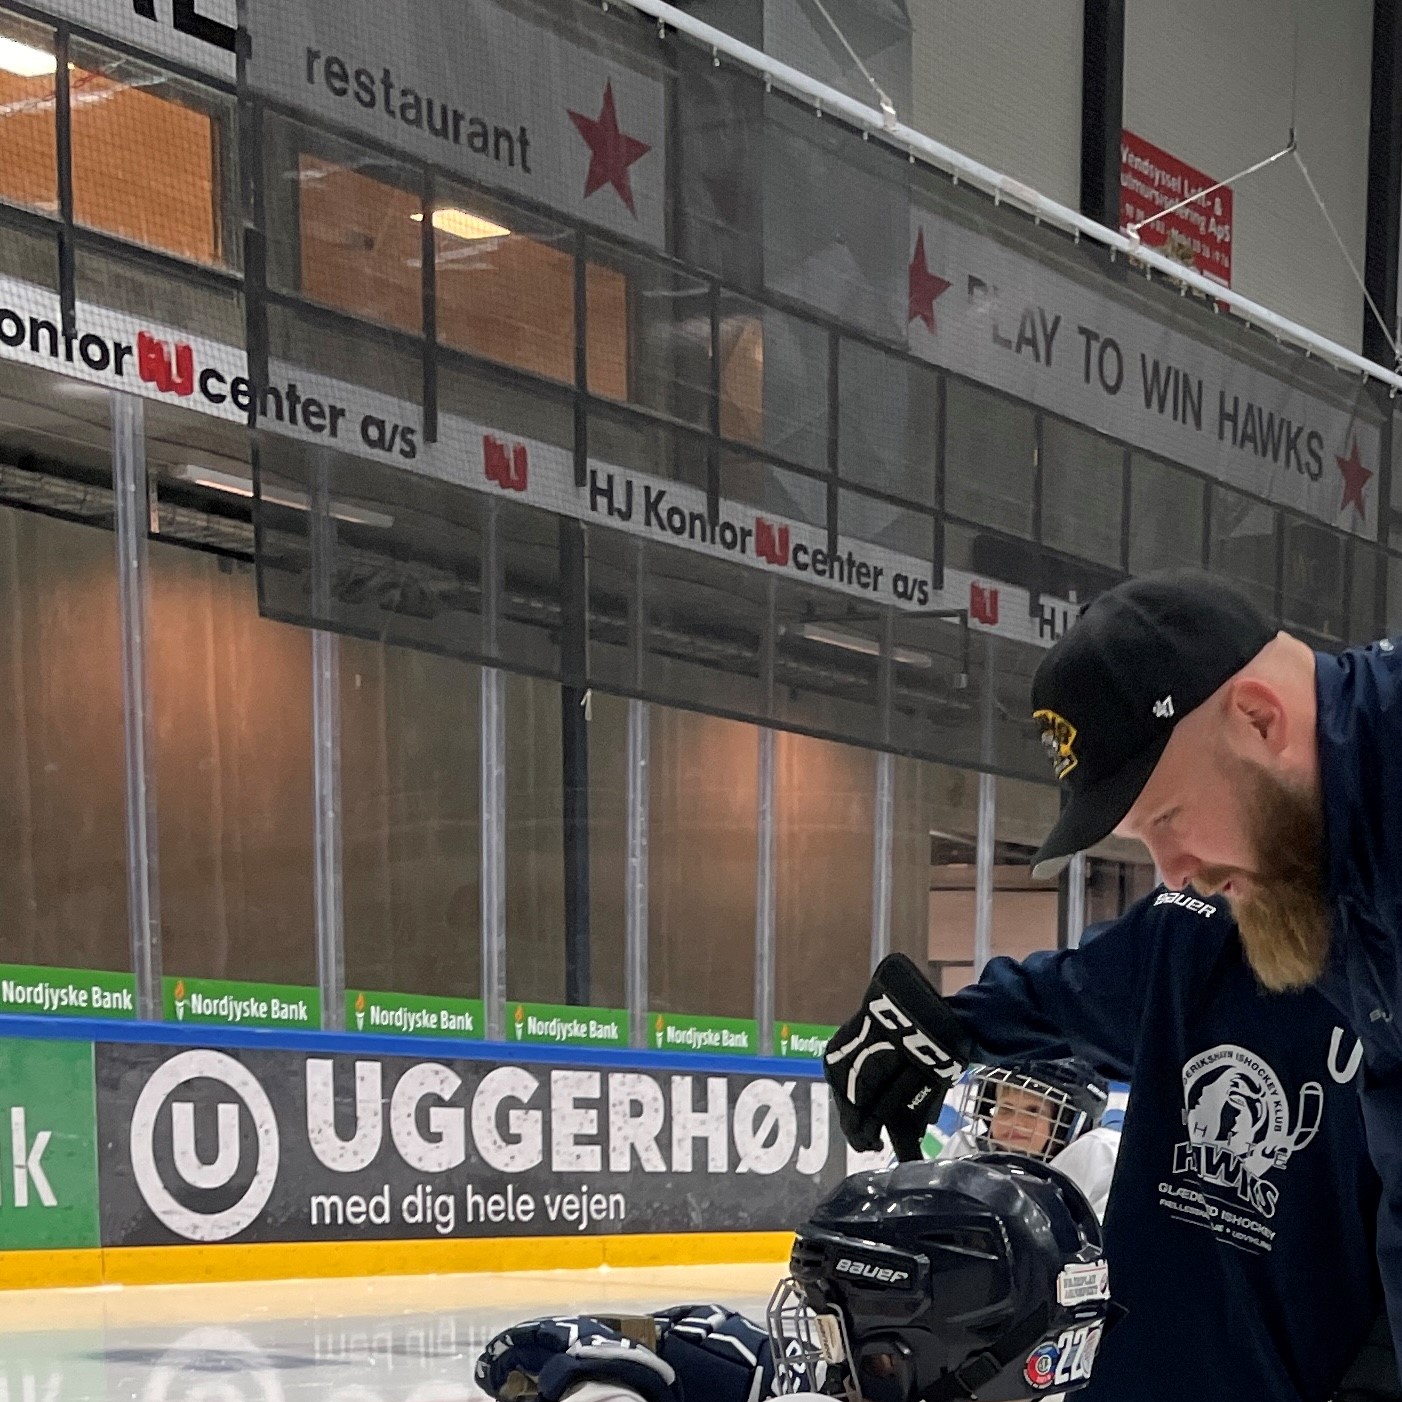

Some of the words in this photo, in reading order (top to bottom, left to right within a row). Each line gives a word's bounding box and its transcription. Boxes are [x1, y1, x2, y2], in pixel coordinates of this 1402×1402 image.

[306, 45, 532, 174] restaurant
[199, 367, 346, 438] center
[361, 414, 417, 460] a/s
[1078, 325, 1124, 396] TO
[1140, 352, 1203, 432] WIN
[1218, 390, 1324, 482] HAWKS
[589, 468, 634, 522] HJ
[792, 542, 884, 593] center
[892, 572, 930, 607] a/s
[1, 979, 88, 1010] Nordjyske
[92, 985, 134, 1011] Bank
[190, 993, 267, 1022] Nordjyske
[271, 999, 309, 1022] Bank
[370, 1005, 437, 1032] Nordjyske
[440, 1009, 474, 1032] Bank
[527, 1016, 587, 1042] Nordjyske
[589, 1021, 619, 1040] Bank
[666, 1025, 720, 1049] Nordjyske
[722, 1029, 749, 1048] Bank
[305, 1058, 832, 1176] UGGERHØJ
[1235, 1053, 1280, 1097] ISHOCKEY
[1273, 1099, 1285, 1133] KLUB
[10, 1106, 58, 1208] k
[311, 1187, 391, 1225] med
[402, 1188, 457, 1234] dig
[466, 1186, 536, 1224] hele
[546, 1184, 626, 1231] vejen
[836, 1258, 909, 1283] BAUER
